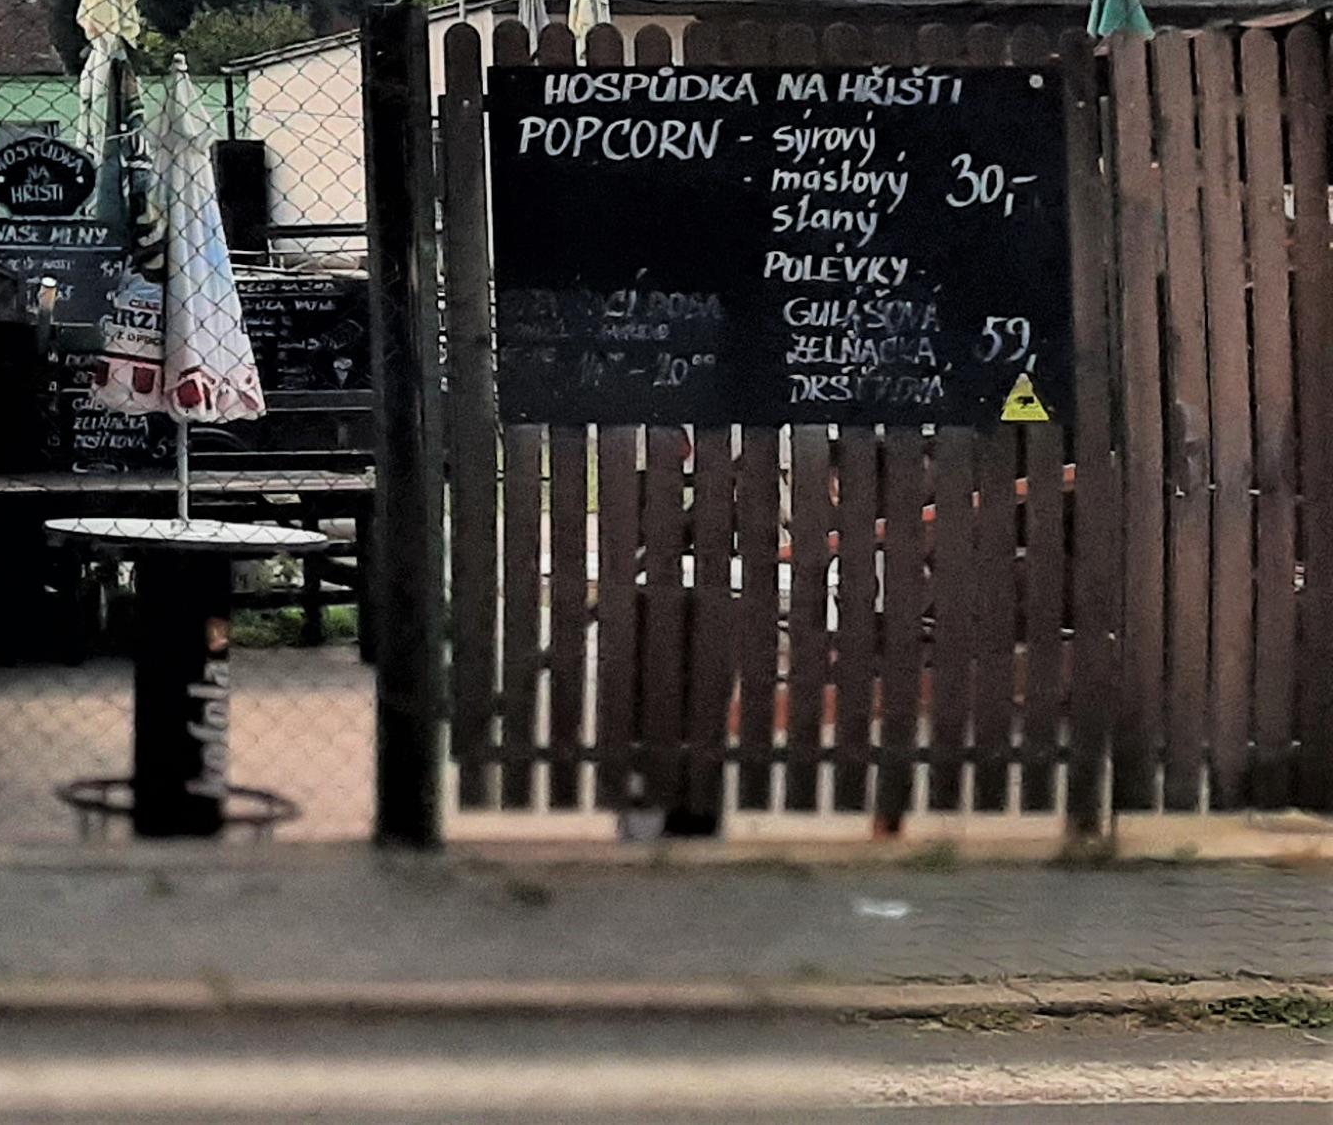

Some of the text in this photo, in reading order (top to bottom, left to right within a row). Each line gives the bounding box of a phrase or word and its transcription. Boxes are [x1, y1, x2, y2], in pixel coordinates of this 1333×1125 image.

[544, 65, 962, 106] HOSPŮDKA NA HŘIŠTI
[518, 116, 724, 161] POPCORN
[772, 109, 876, 168] sýrový
[771, 151, 909, 214] máslový
[772, 193, 879, 248] slaný
[764, 242, 909, 286] POLÉVKY
